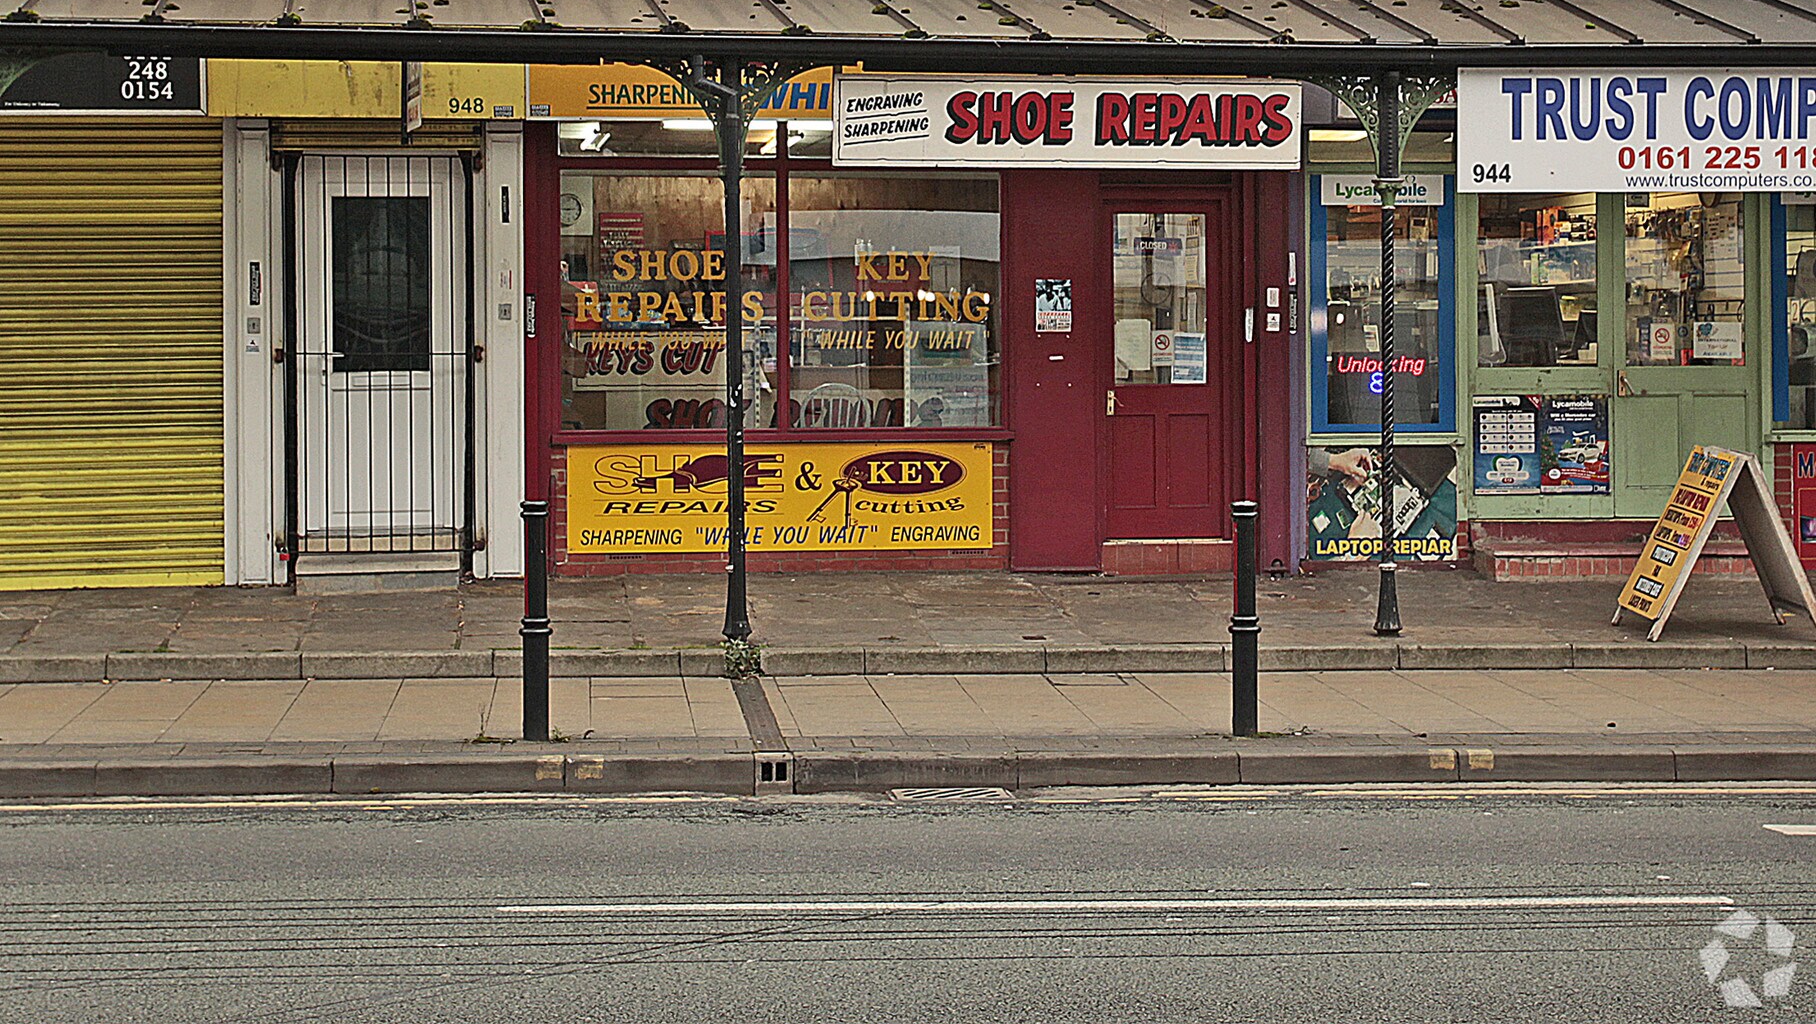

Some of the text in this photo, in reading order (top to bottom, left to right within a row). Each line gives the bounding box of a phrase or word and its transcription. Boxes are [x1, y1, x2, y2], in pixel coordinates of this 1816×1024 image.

[129, 61, 168, 80] 248
[120, 81, 174, 100] 0154
[588, 83, 699, 105] SHARPENI
[449, 97, 484, 114] 948
[846, 92, 923, 113] ENGRAVING
[1501, 77, 1816, 141] TRUST COMP
[844, 117, 929, 138] SHARPENING
[945, 91, 1293, 147] SHOE REPAIRS
[1618, 146, 1816, 170] 0161 225 11
[1472, 163, 1512, 184] 944
[1335, 182, 1427, 199] Lycabile
[1140, 241, 1168, 250] CLOSED
[613, 249, 726, 281] SHOE
[856, 250, 937, 281] KEY
[575, 291, 764, 322] REPAIRS
[804, 290, 990, 322] CUTTING
[703, 331, 751, 350] WT
[884, 330, 920, 350] YOU
[583, 339, 727, 375] KEYS CUT
[643, 398, 753, 429] SHO
[1552, 400, 1594, 409] Lycamobile
[594, 454, 950, 495] SHOE & KEY
[855, 496, 966, 514] cutting
[580, 529, 683, 546] SHARPENING
[696, 526, 764, 546] "WLE
[773, 526, 809, 545] YOU
[891, 525, 980, 542] ENGRAVING
[1316, 539, 1383, 555] LAPTOP
